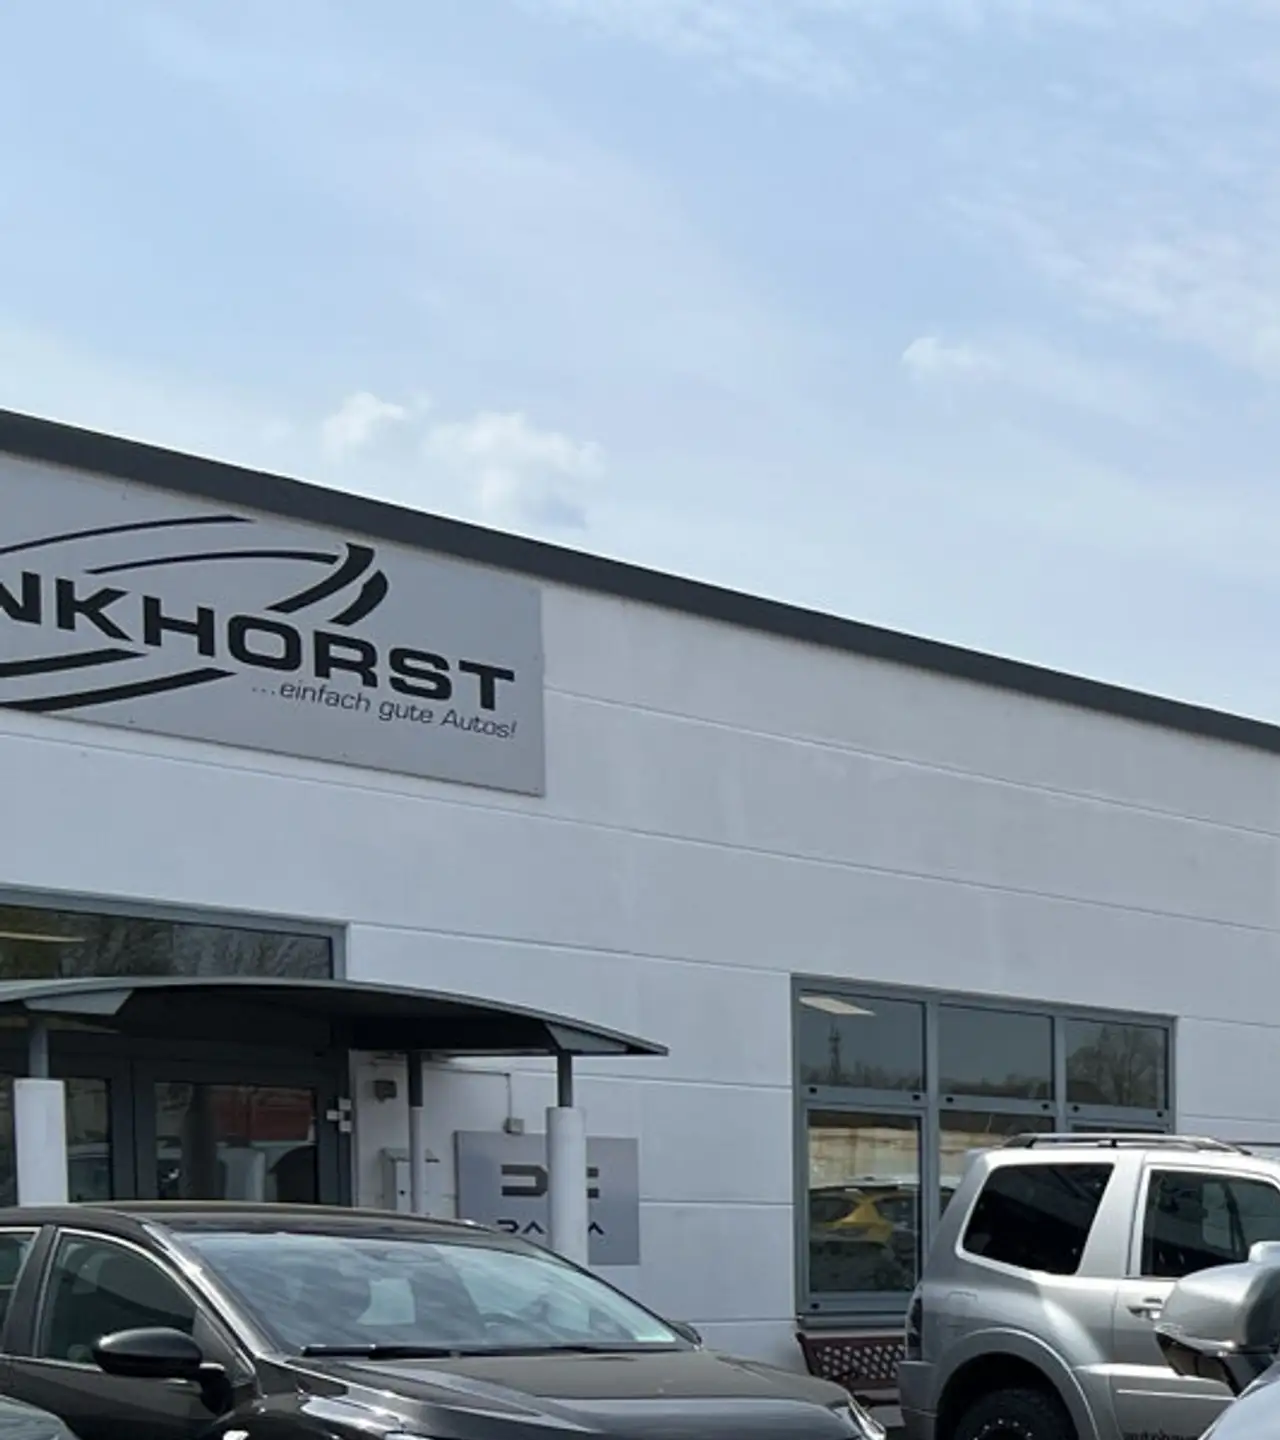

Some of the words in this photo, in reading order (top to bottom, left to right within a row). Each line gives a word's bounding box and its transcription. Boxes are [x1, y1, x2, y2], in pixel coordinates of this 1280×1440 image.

[378, 700, 434, 722] gute
[439, 708, 518, 739] Autos!
[497, 1219, 605, 1236] DAA
